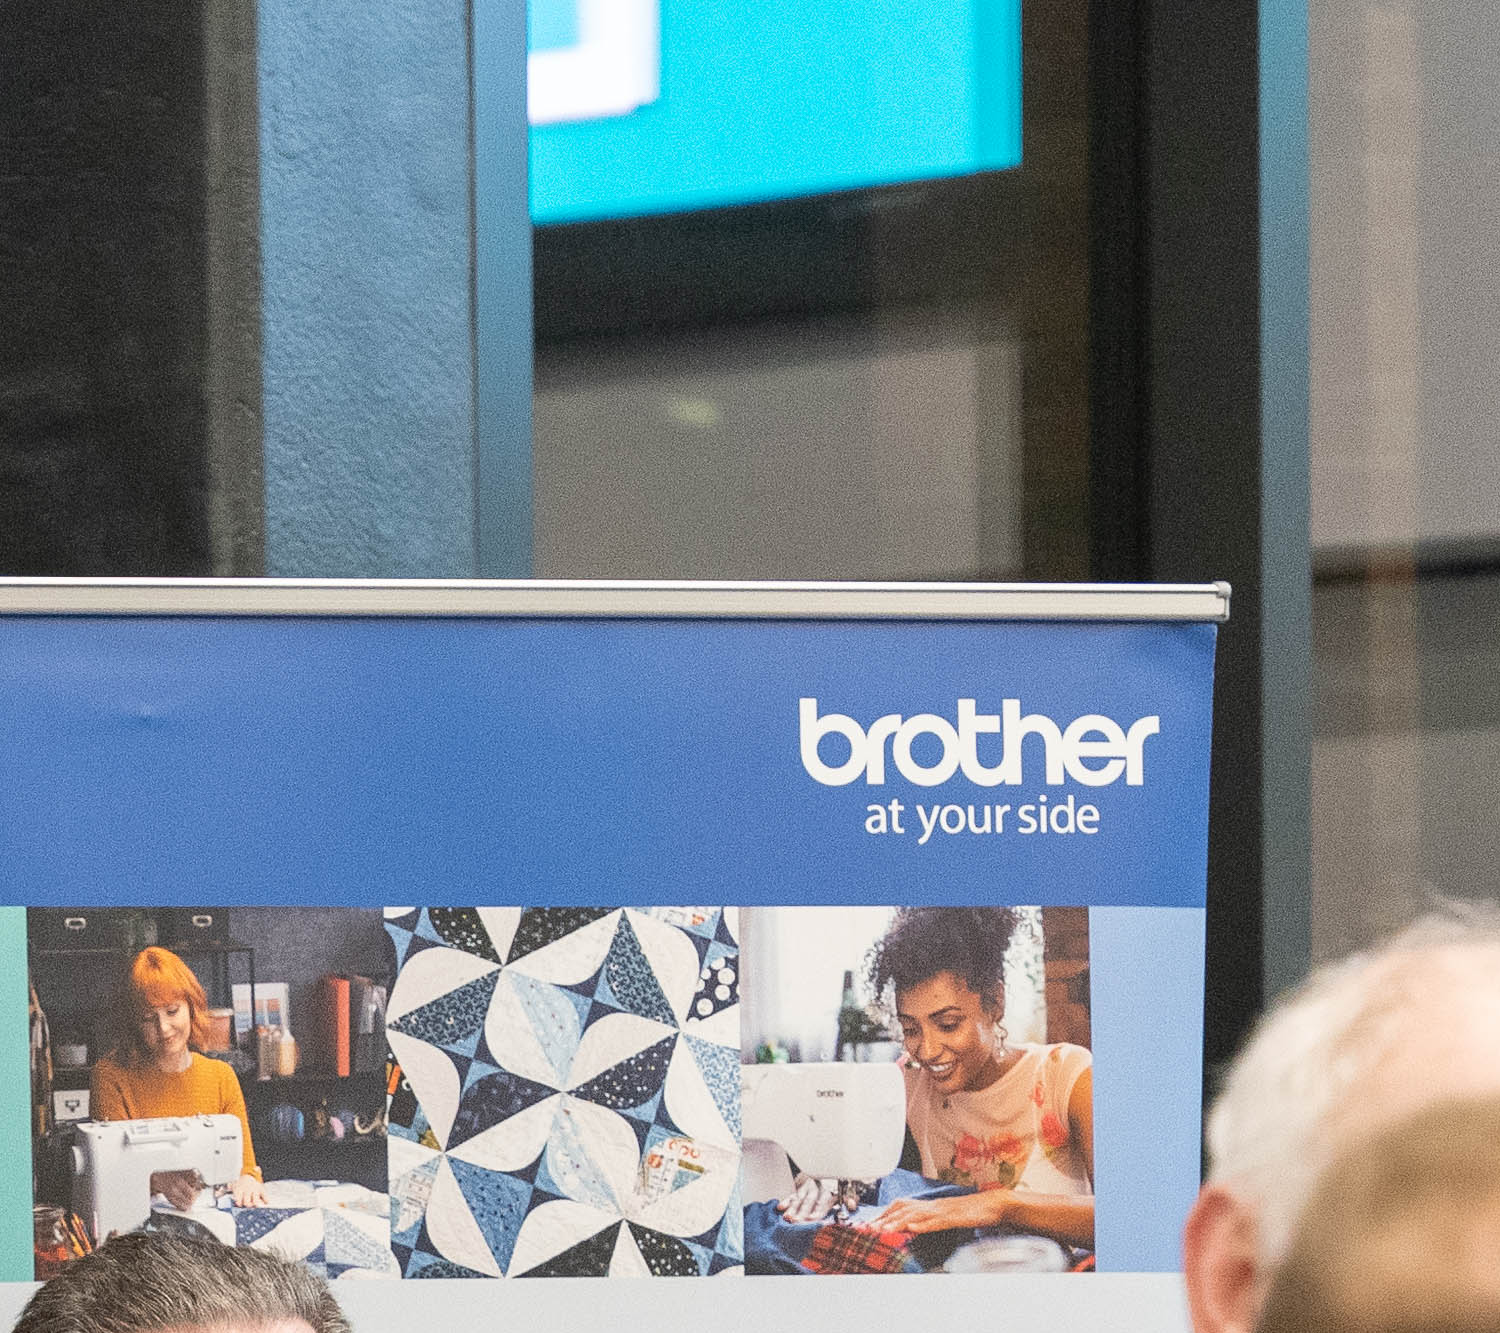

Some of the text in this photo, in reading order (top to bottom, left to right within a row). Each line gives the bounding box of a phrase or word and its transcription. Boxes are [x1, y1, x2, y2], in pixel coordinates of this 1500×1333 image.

[799, 697, 1160, 787] brother
[865, 794, 1100, 845] at your side
